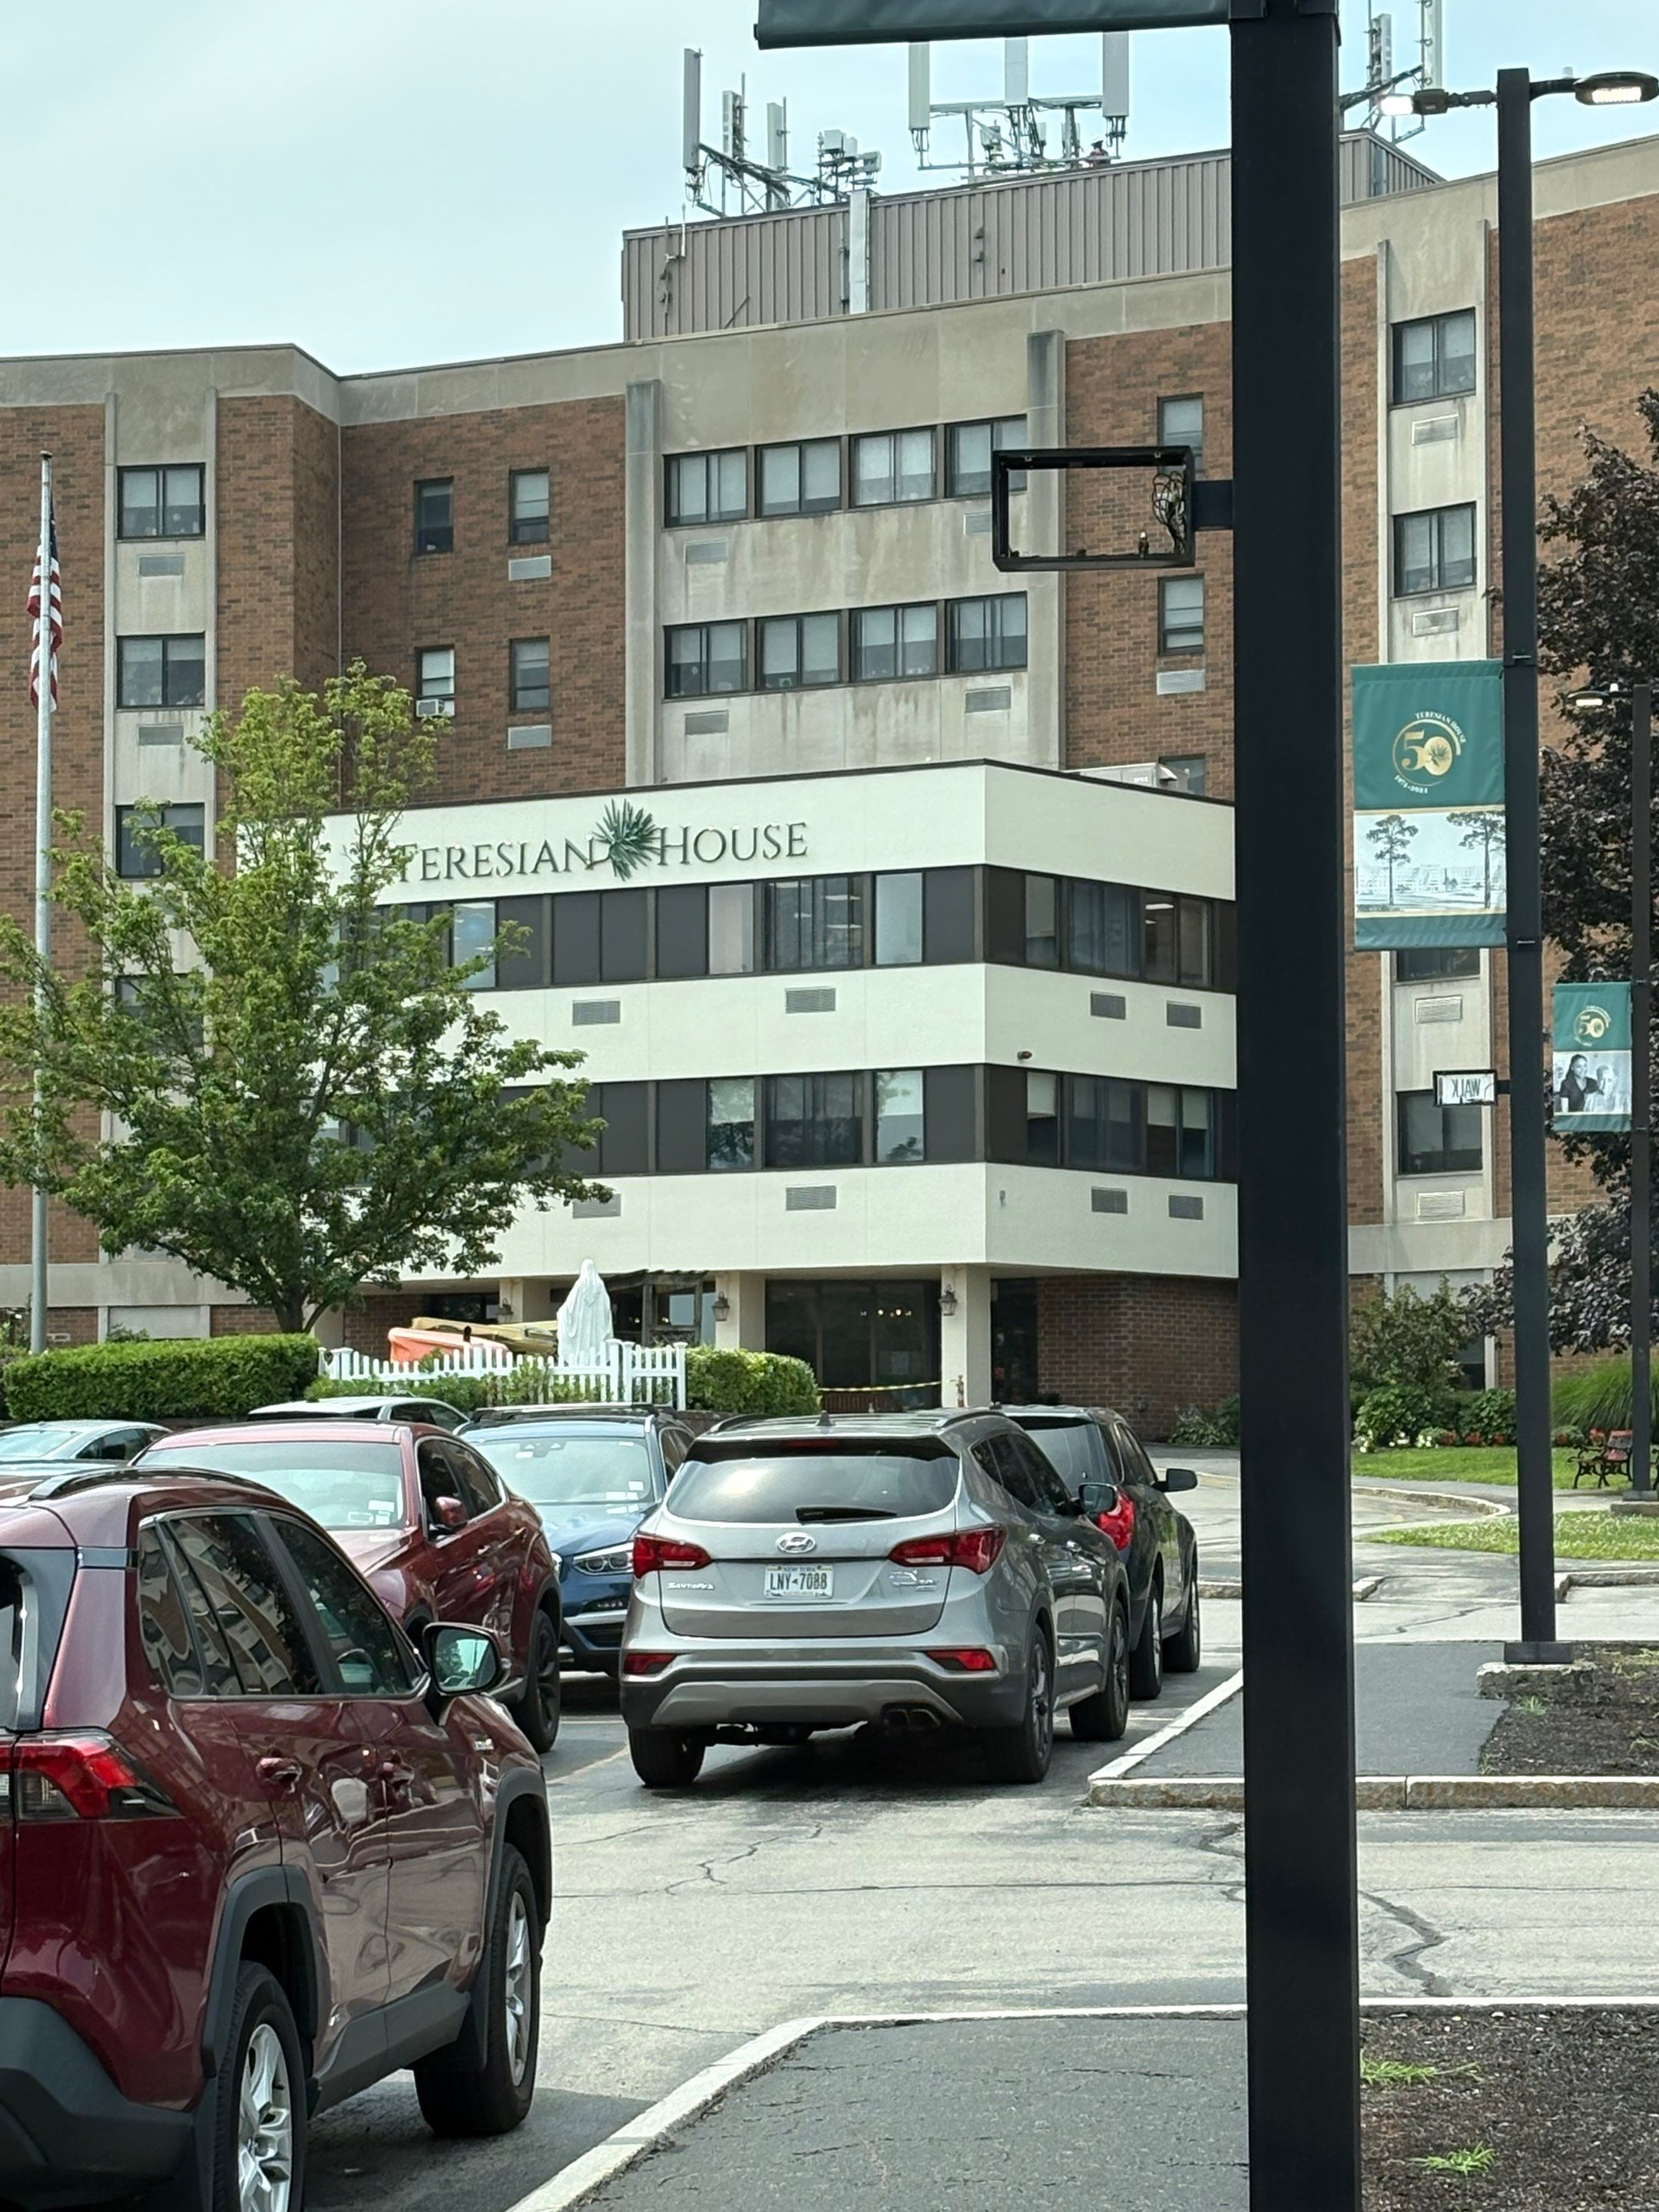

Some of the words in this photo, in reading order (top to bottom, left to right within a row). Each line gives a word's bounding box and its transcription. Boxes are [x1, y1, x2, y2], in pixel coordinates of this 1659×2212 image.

[1402, 730, 1453, 776] 50
[397, 833, 594, 882] TERESIAN
[657, 822, 808, 866] HOUSE
[770, 1572, 792, 1590] LNY
